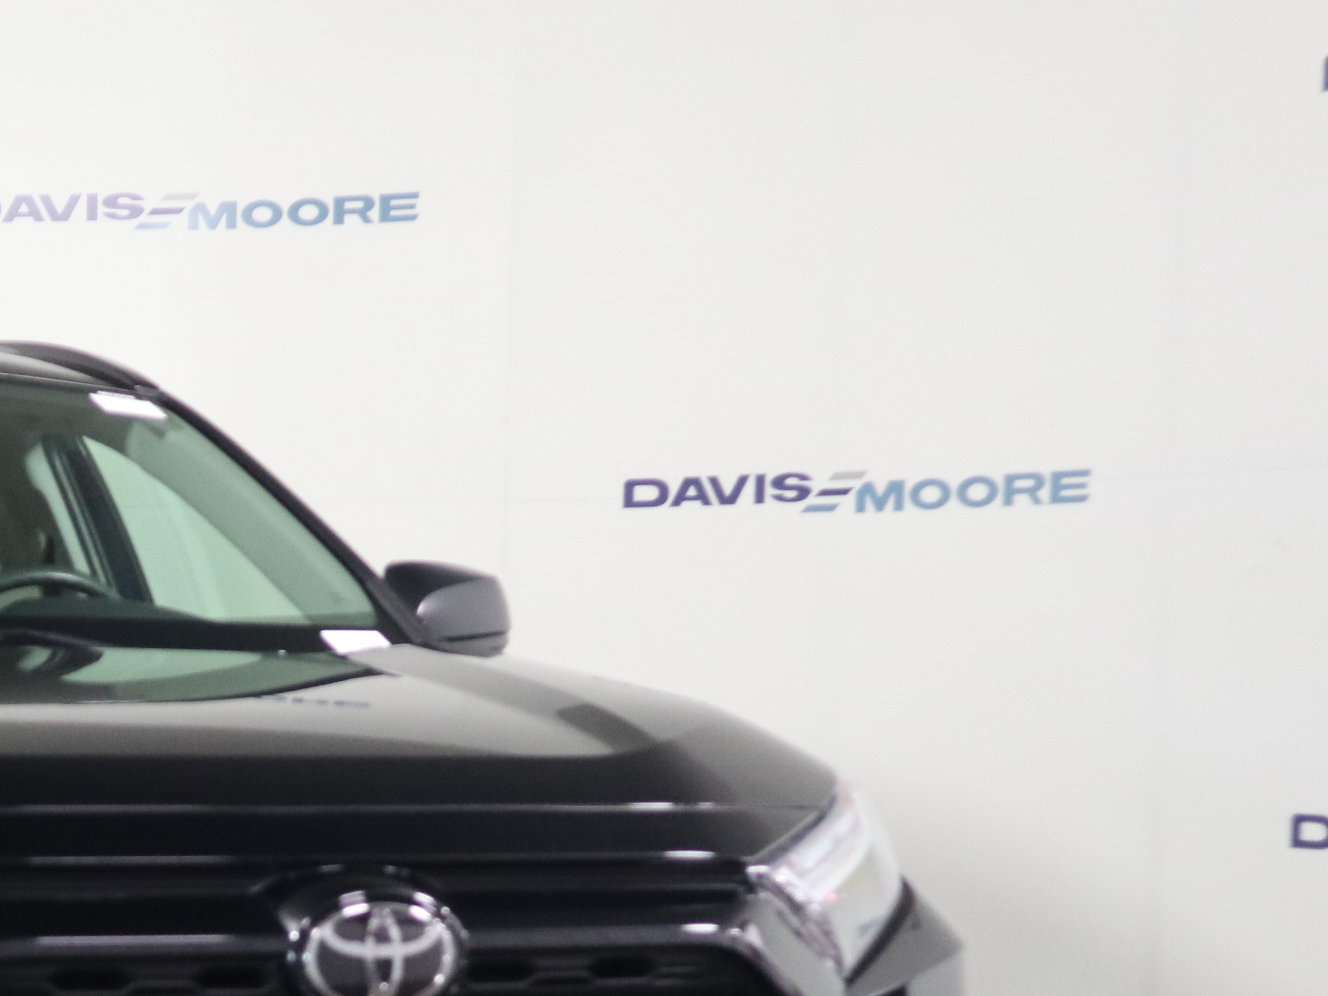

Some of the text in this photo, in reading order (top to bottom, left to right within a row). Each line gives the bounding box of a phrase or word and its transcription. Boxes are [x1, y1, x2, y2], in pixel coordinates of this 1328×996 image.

[187, 191, 420, 231] MOORE
[622, 468, 1092, 514] DAVIS MOORE
